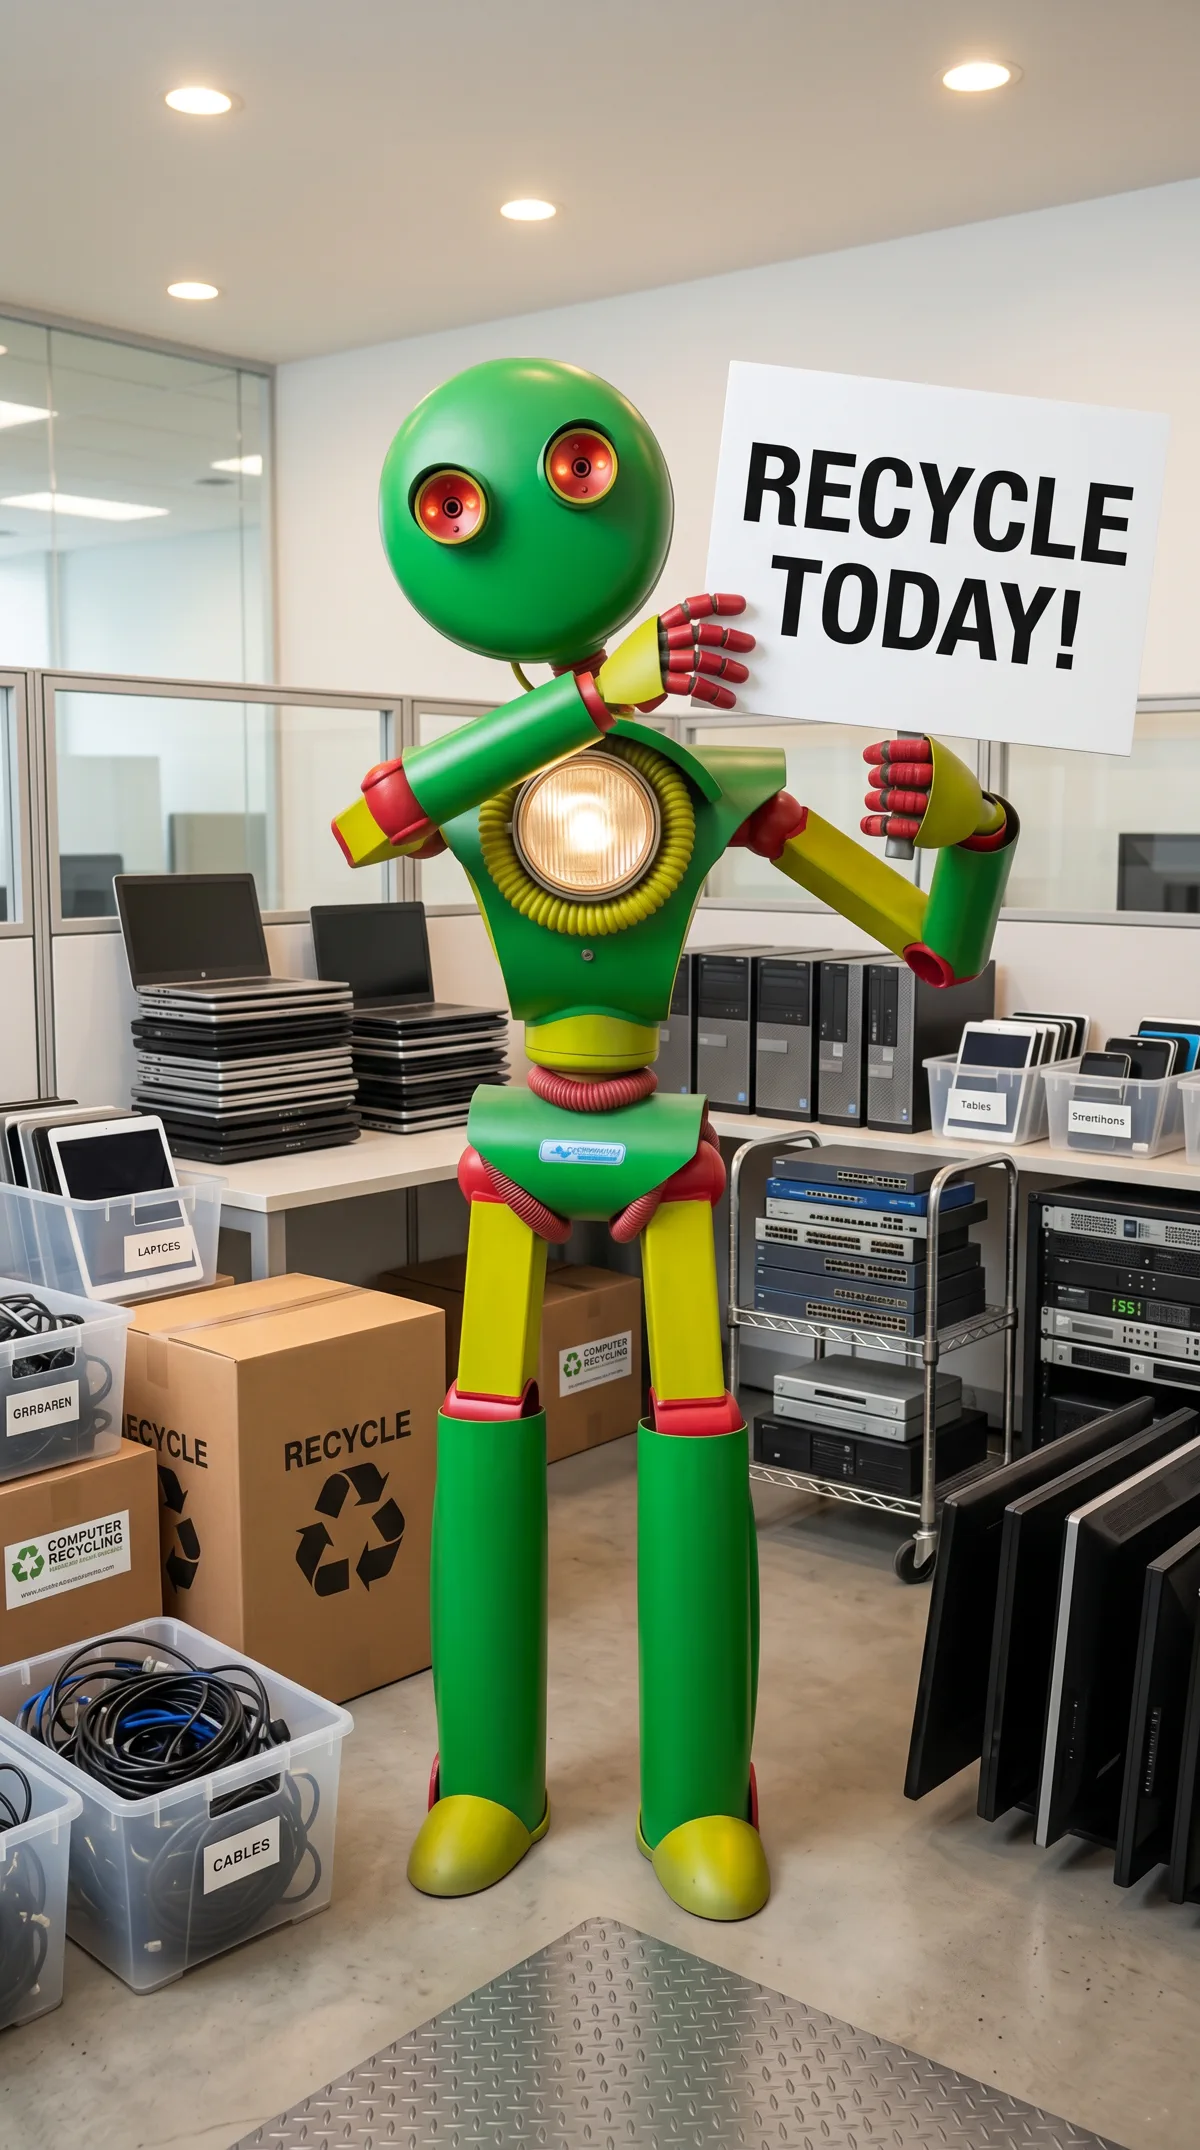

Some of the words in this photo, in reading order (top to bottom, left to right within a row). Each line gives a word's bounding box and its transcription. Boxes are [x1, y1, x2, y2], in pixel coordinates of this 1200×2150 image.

[743, 441, 1134, 566] RECYCLE
[771, 554, 1082, 670] TODAY!
[961, 1100, 991, 1111] Tables
[583, 1338, 628, 1357] COMPUTER
[583, 1347, 628, 1367] RECYCLING
[13, 1396, 72, 1419] GRRBAREN
[122, 1413, 208, 1469] ECYCLE
[284, 1409, 412, 1471] RECYCLE
[47, 1519, 122, 1551] COMPUTER
[48, 1532, 123, 1565] RECYCLING
[213, 1838, 270, 1872] CABLES
